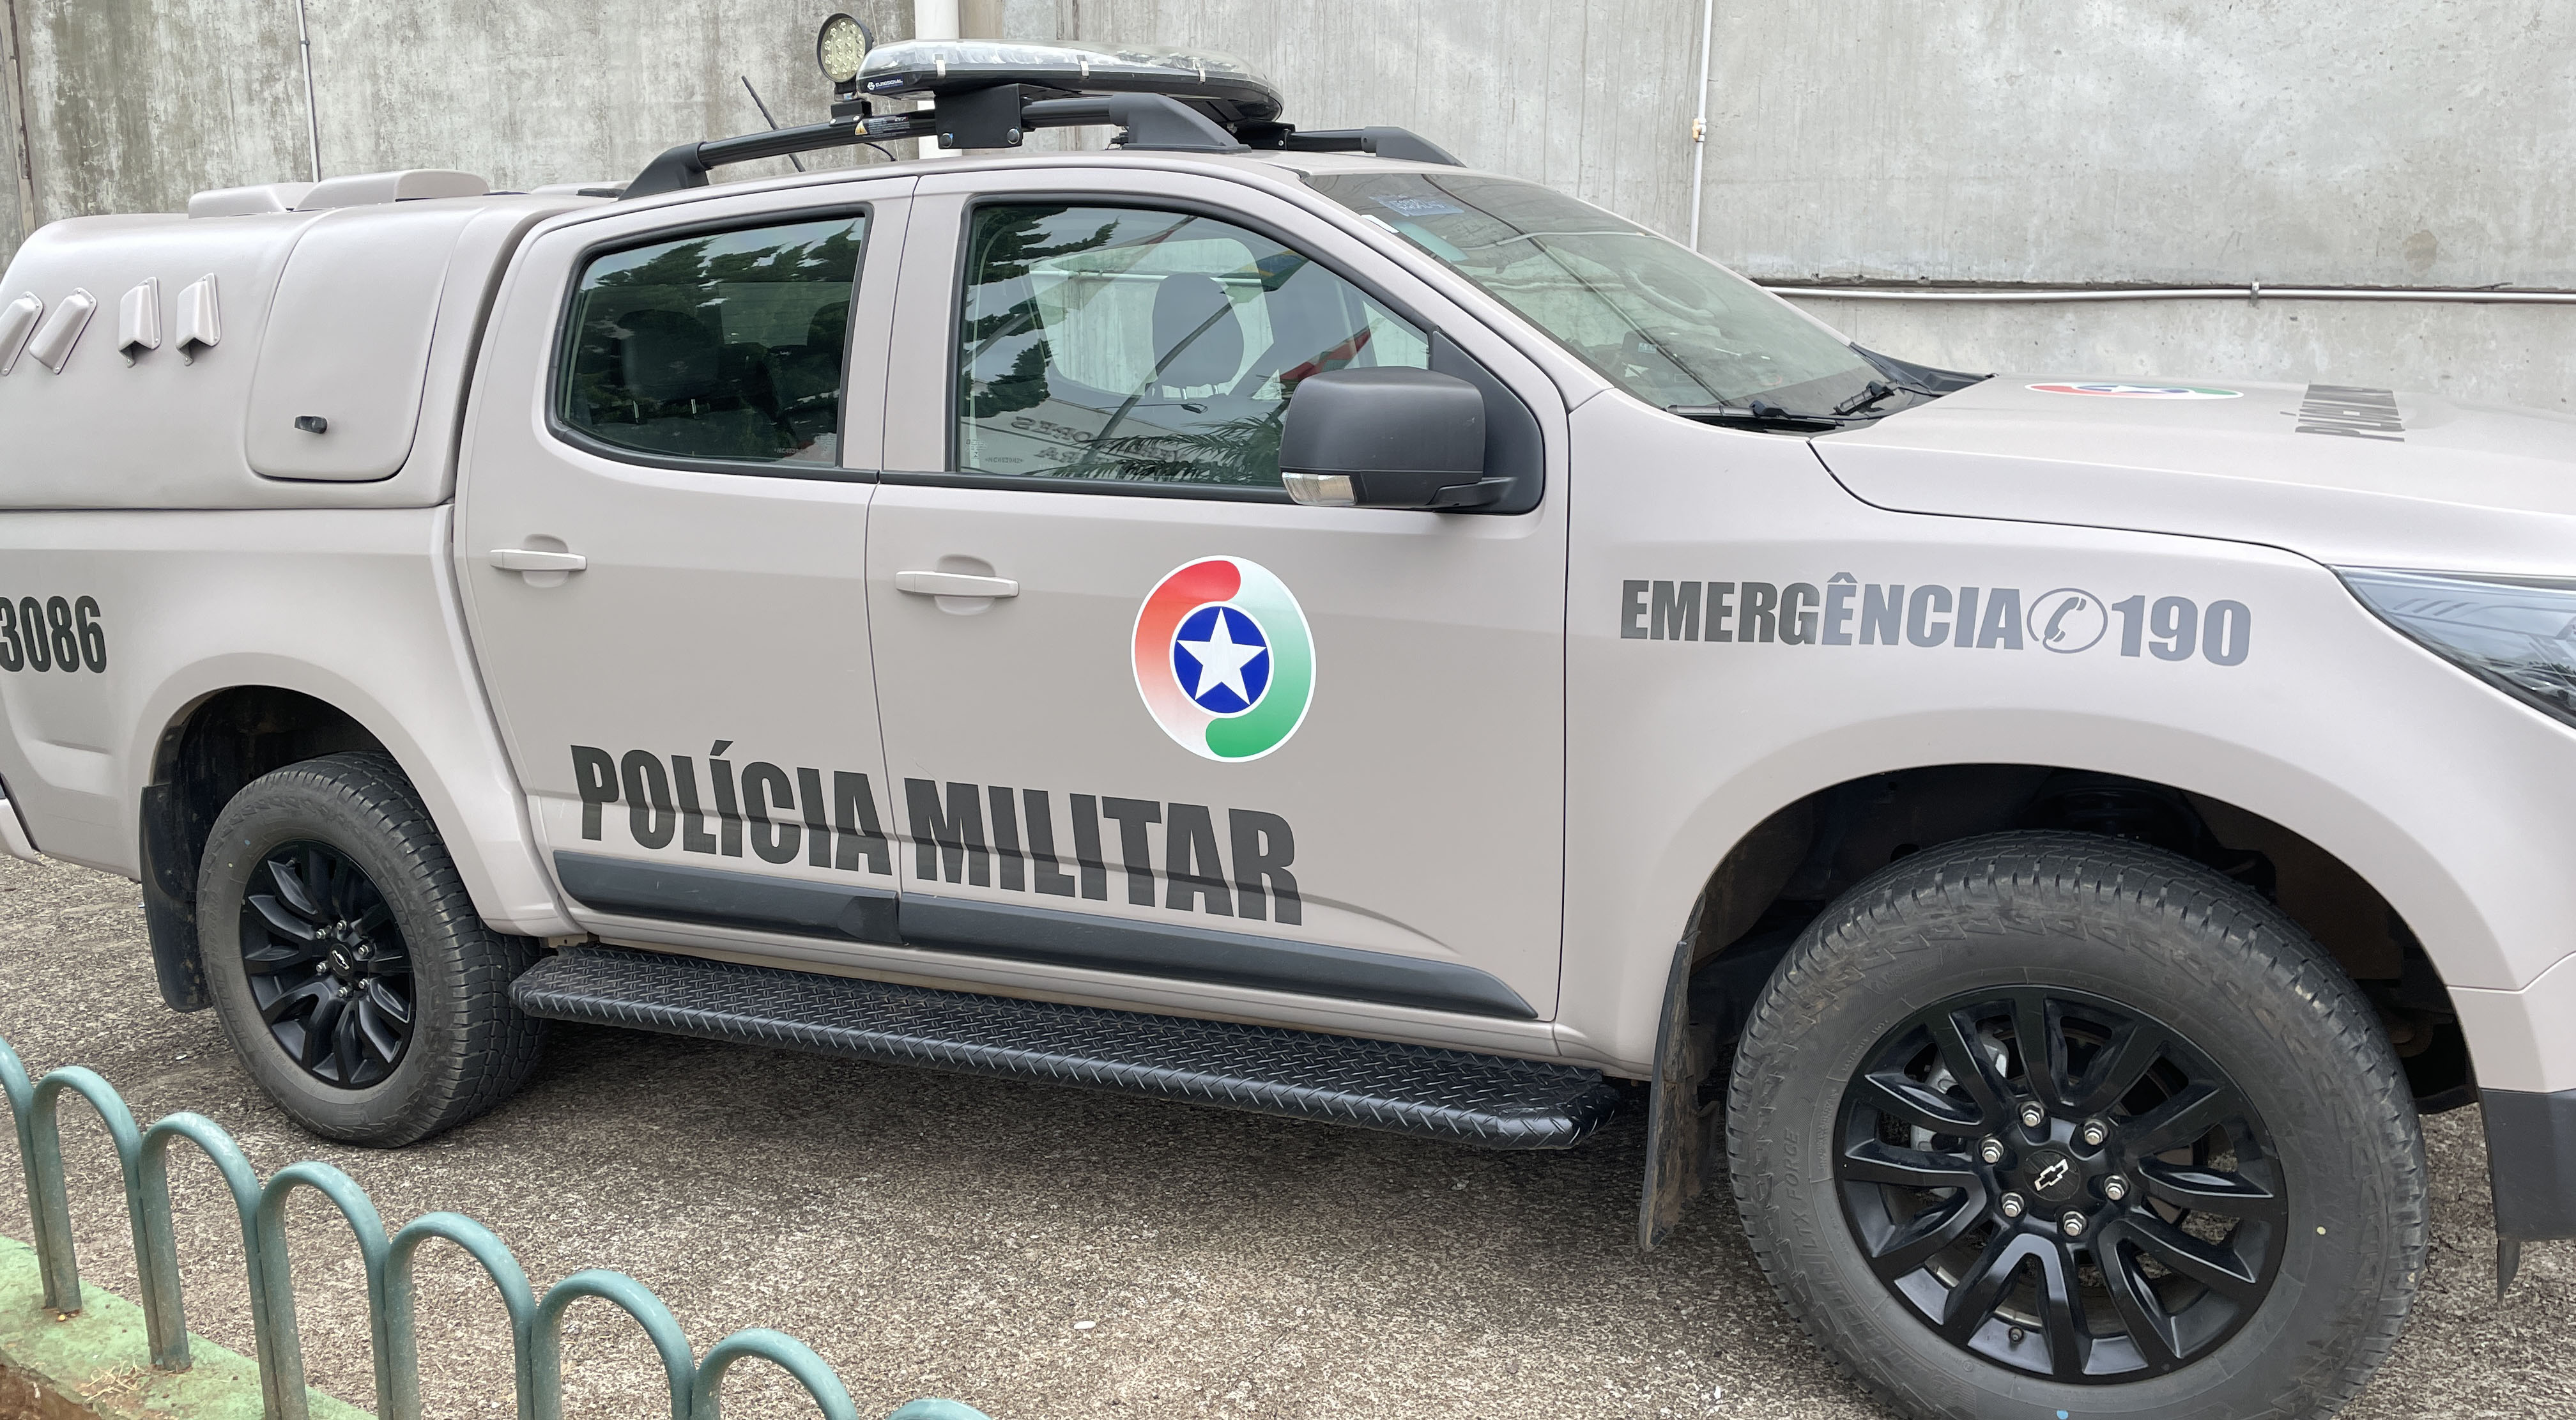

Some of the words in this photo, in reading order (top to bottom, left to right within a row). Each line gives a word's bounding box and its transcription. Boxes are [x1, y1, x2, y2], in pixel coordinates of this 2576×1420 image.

[0, 595, 107, 674] 3086
[1620, 571, 2024, 651] EMERGÊNCIA
[2111, 594, 2252, 667] 190
[570, 739, 893, 876] POLÍCIA
[903, 776, 1303, 927] MILITAR
[1783, 1132, 1807, 1201] FORCE
[1790, 1212, 1818, 1249] LTX
